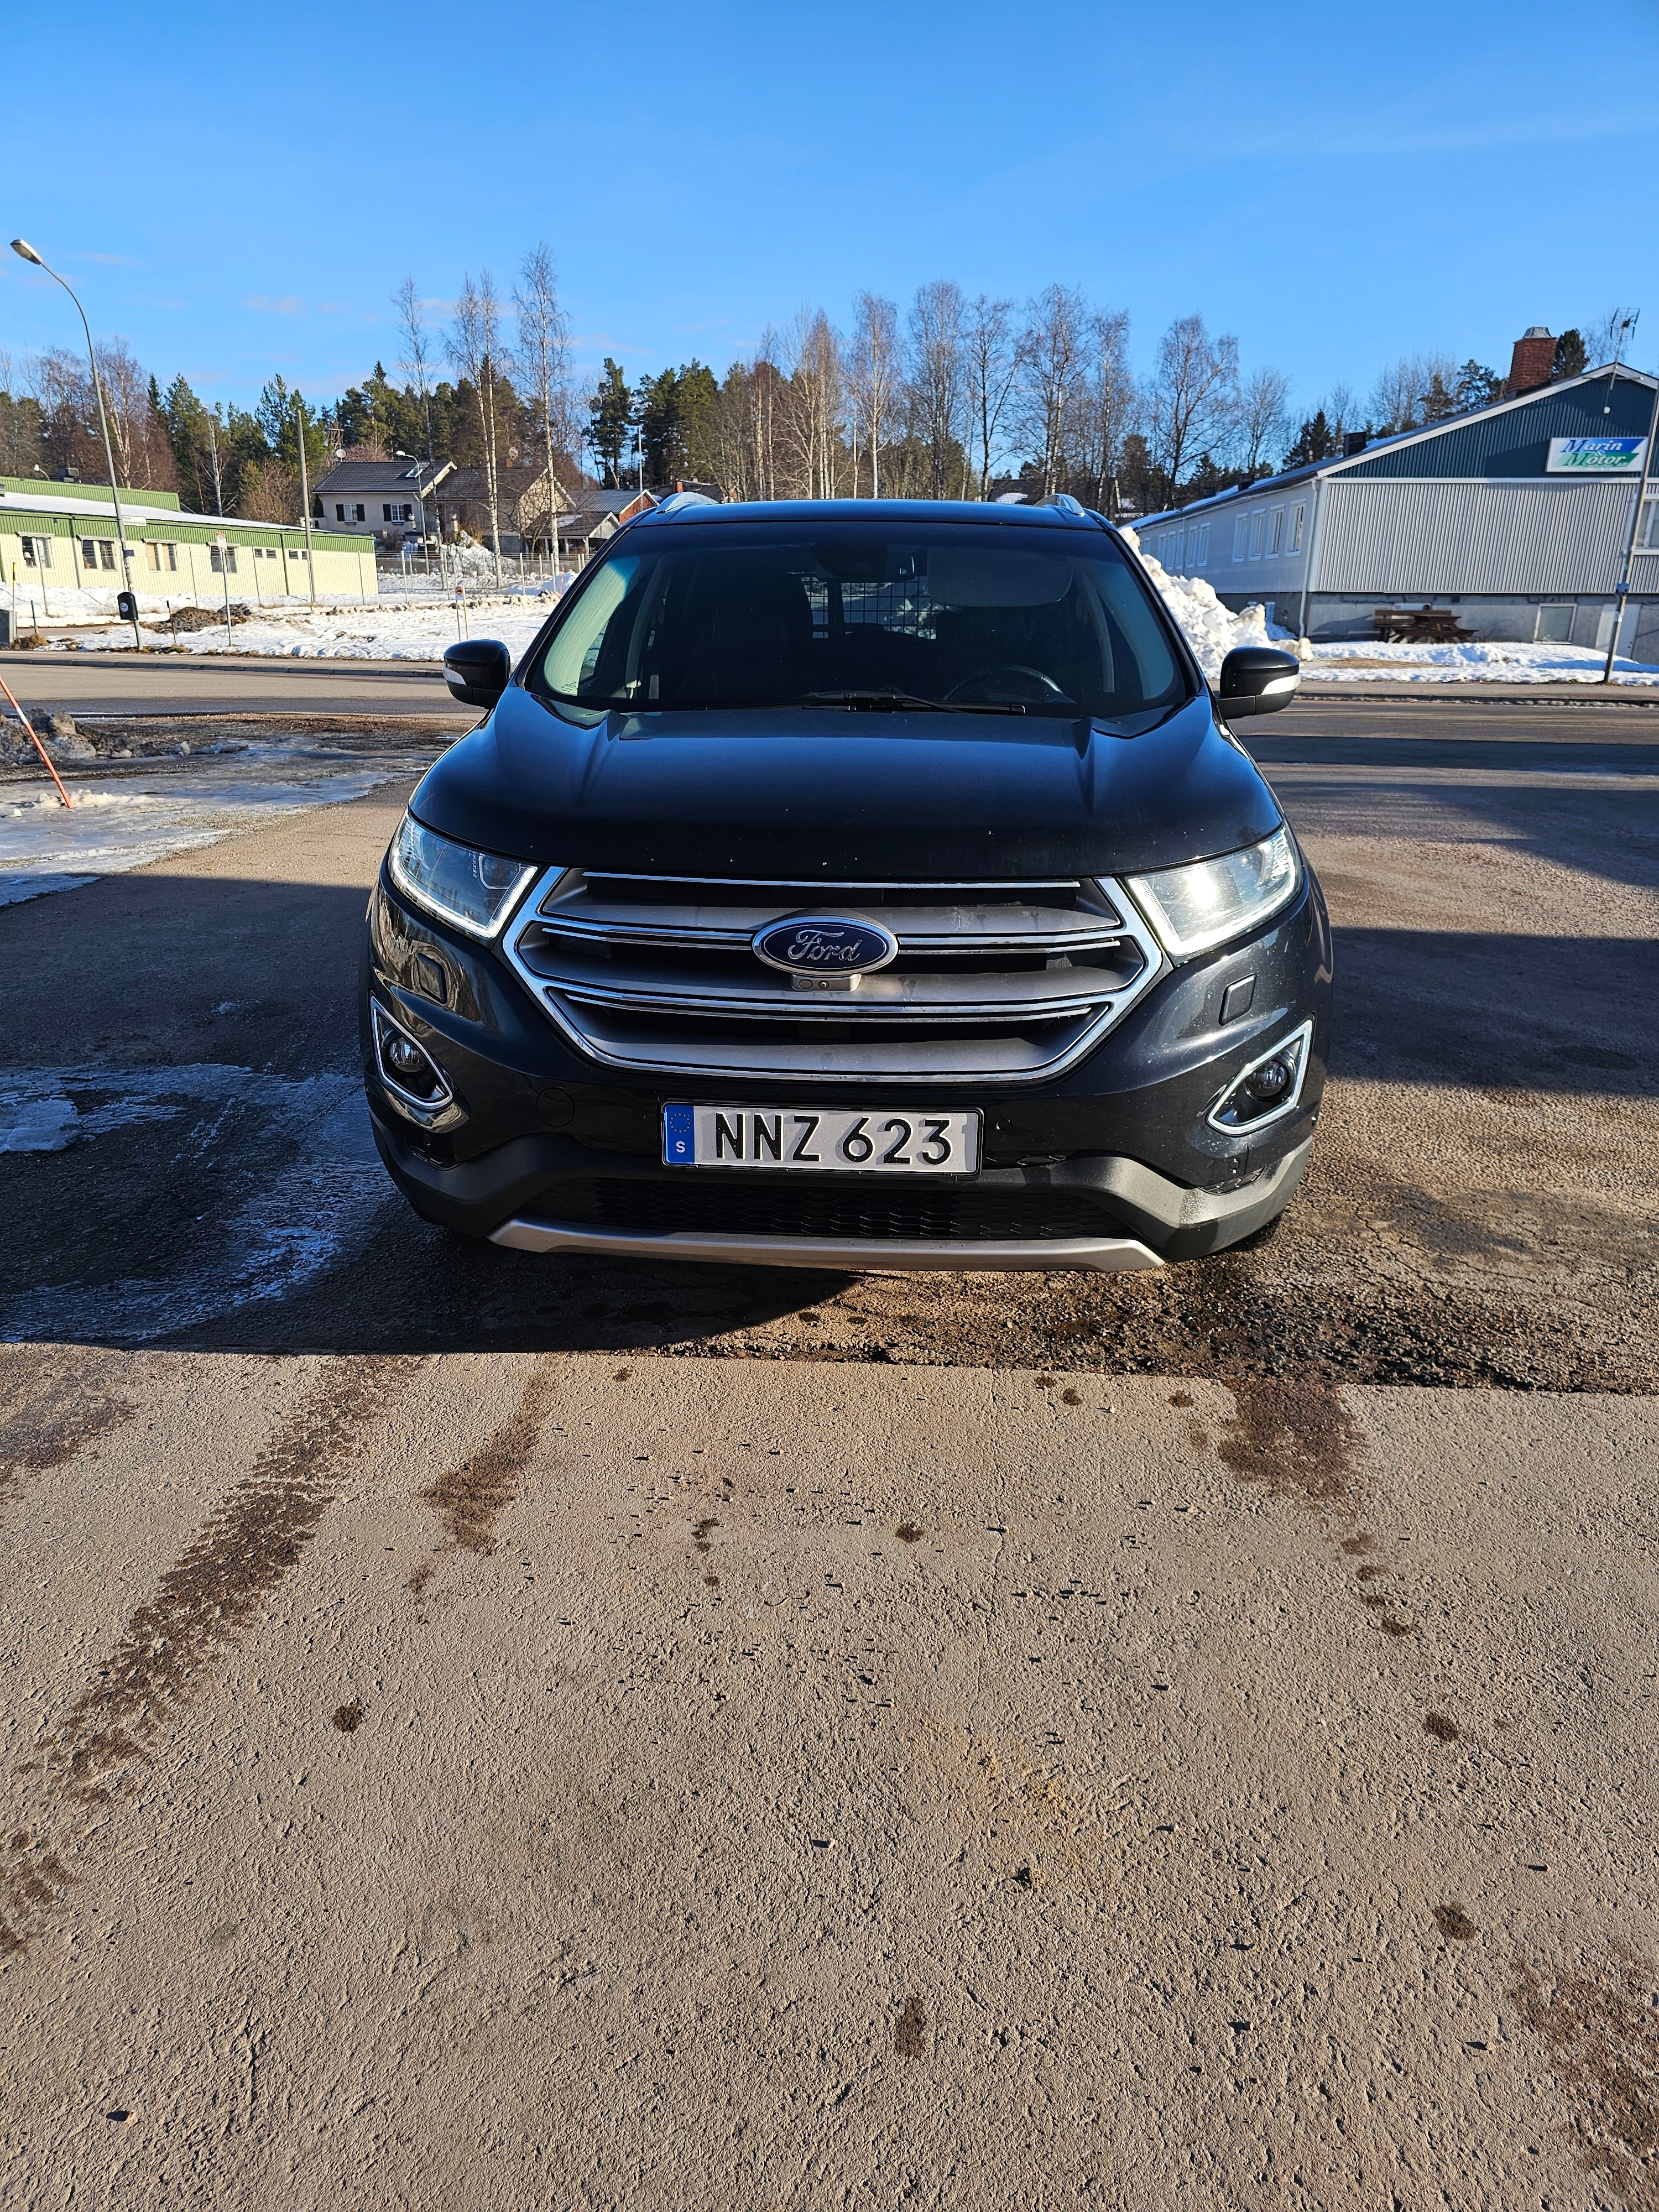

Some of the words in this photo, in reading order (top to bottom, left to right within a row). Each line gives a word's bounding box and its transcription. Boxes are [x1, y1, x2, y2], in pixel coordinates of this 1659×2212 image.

[1560, 440, 1623, 453] Marin
[1562, 452, 1627, 466] Motor
[787, 930, 862, 962] Ford
[716, 1112, 822, 1162] NNZ
[842, 1116, 953, 1165] 623
[676, 1140, 686, 1153] S
